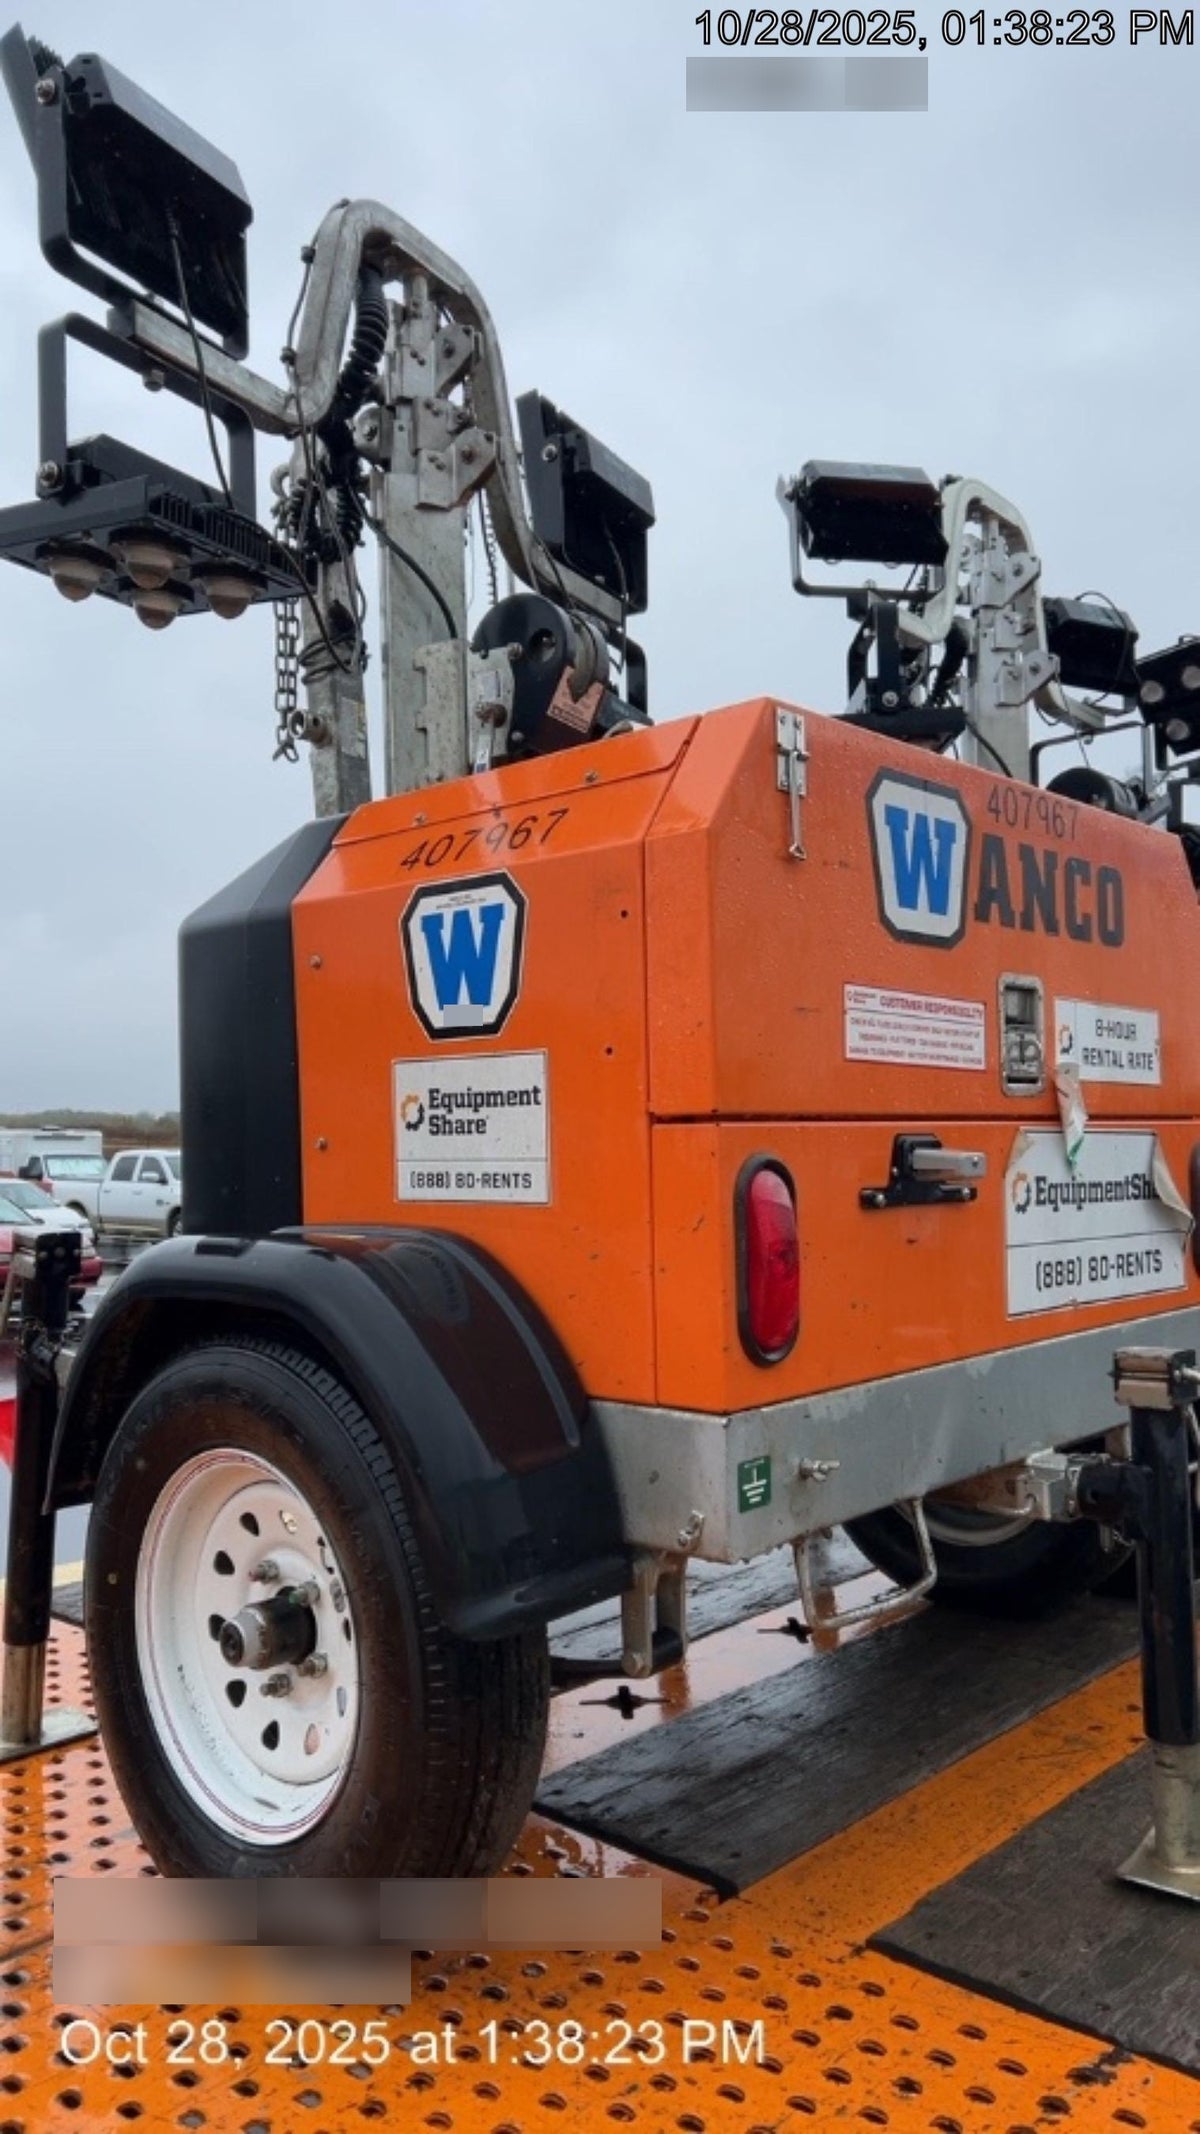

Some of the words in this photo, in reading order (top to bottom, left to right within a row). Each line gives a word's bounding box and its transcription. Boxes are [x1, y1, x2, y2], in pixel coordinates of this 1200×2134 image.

[986, 784, 1079, 842] 407967
[400, 808, 570, 871] 407967
[421, 903, 506, 1011] W
[1095, 1018, 1138, 1041] 8-HOUR
[1082, 1046, 1124, 1069] RENTAL
[1127, 1051, 1154, 1071] RATE
[428, 1085, 542, 1115] Equipment
[428, 1114, 488, 1136] Share
[410, 1170, 450, 1189] (888)
[1035, 1255, 1083, 1292] (888)
[1087, 1249, 1163, 1283] 80-RENTS
